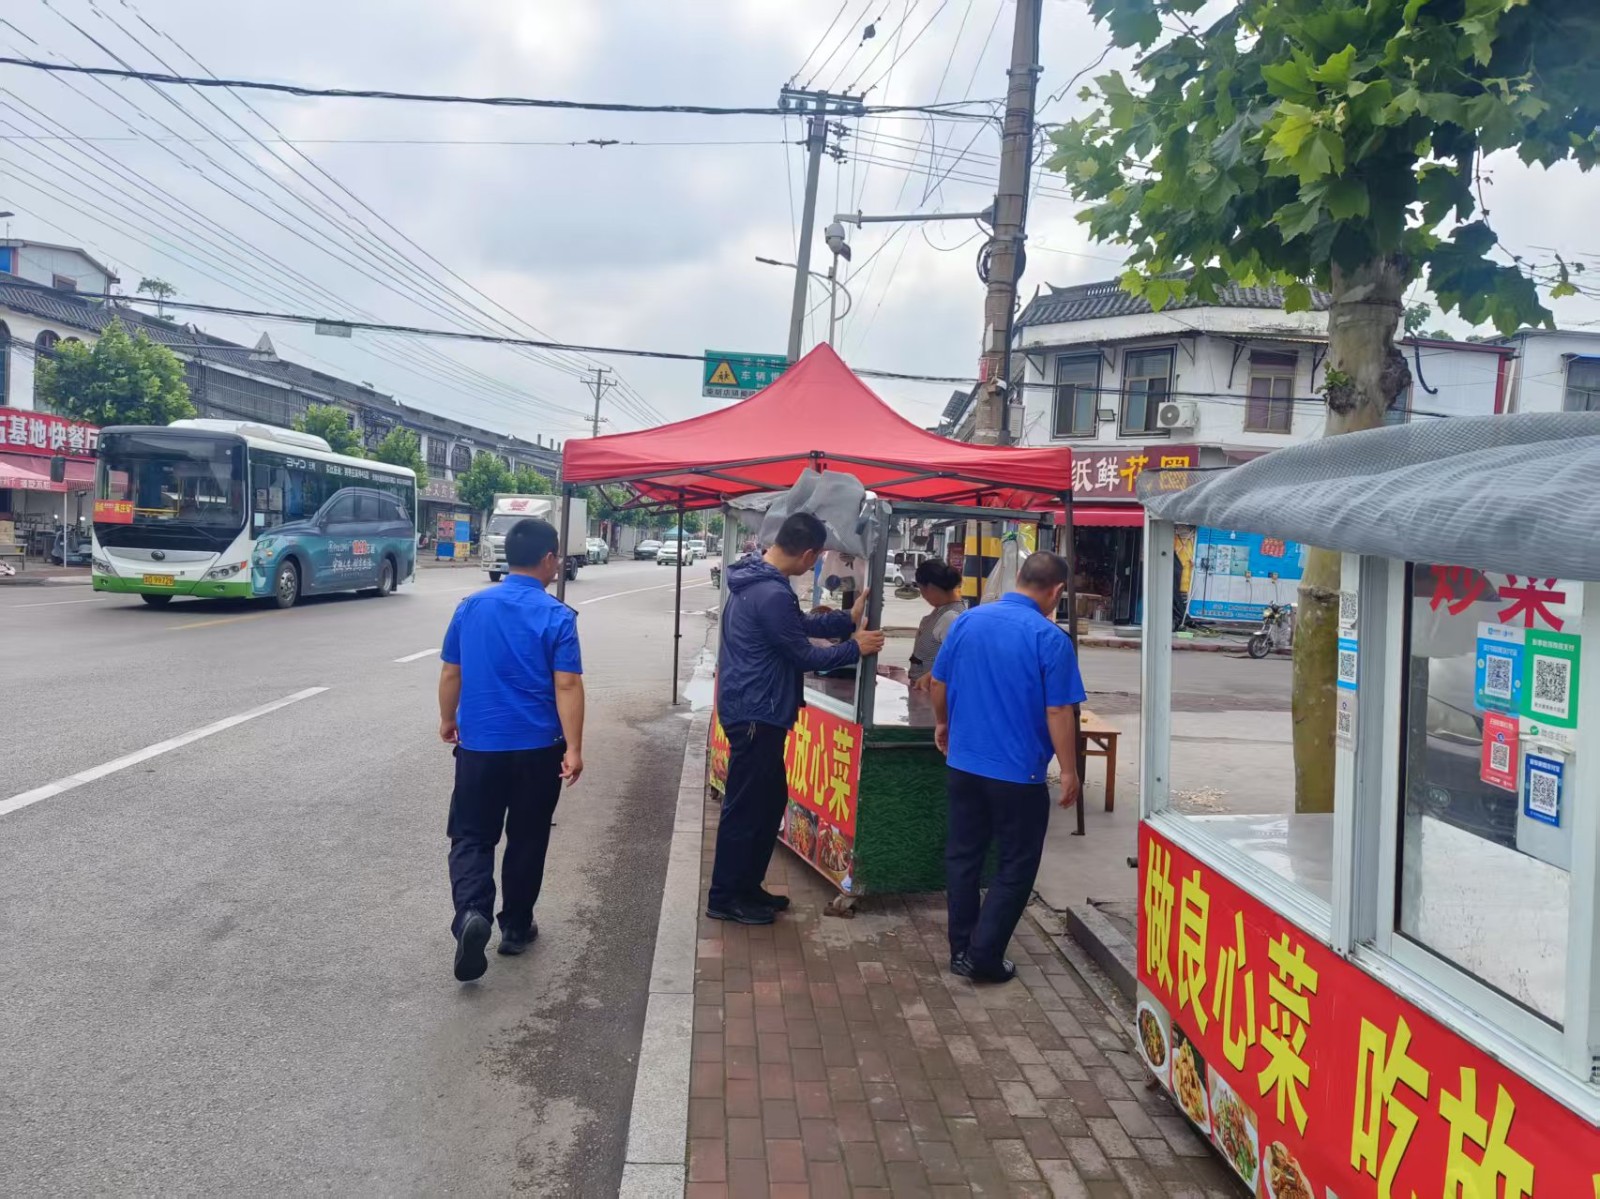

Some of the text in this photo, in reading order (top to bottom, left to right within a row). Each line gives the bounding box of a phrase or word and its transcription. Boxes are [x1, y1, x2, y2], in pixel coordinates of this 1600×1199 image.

[783, 707, 854, 822] 放心菜
[1144, 837, 1600, 1199] 做良心菜 吃放
